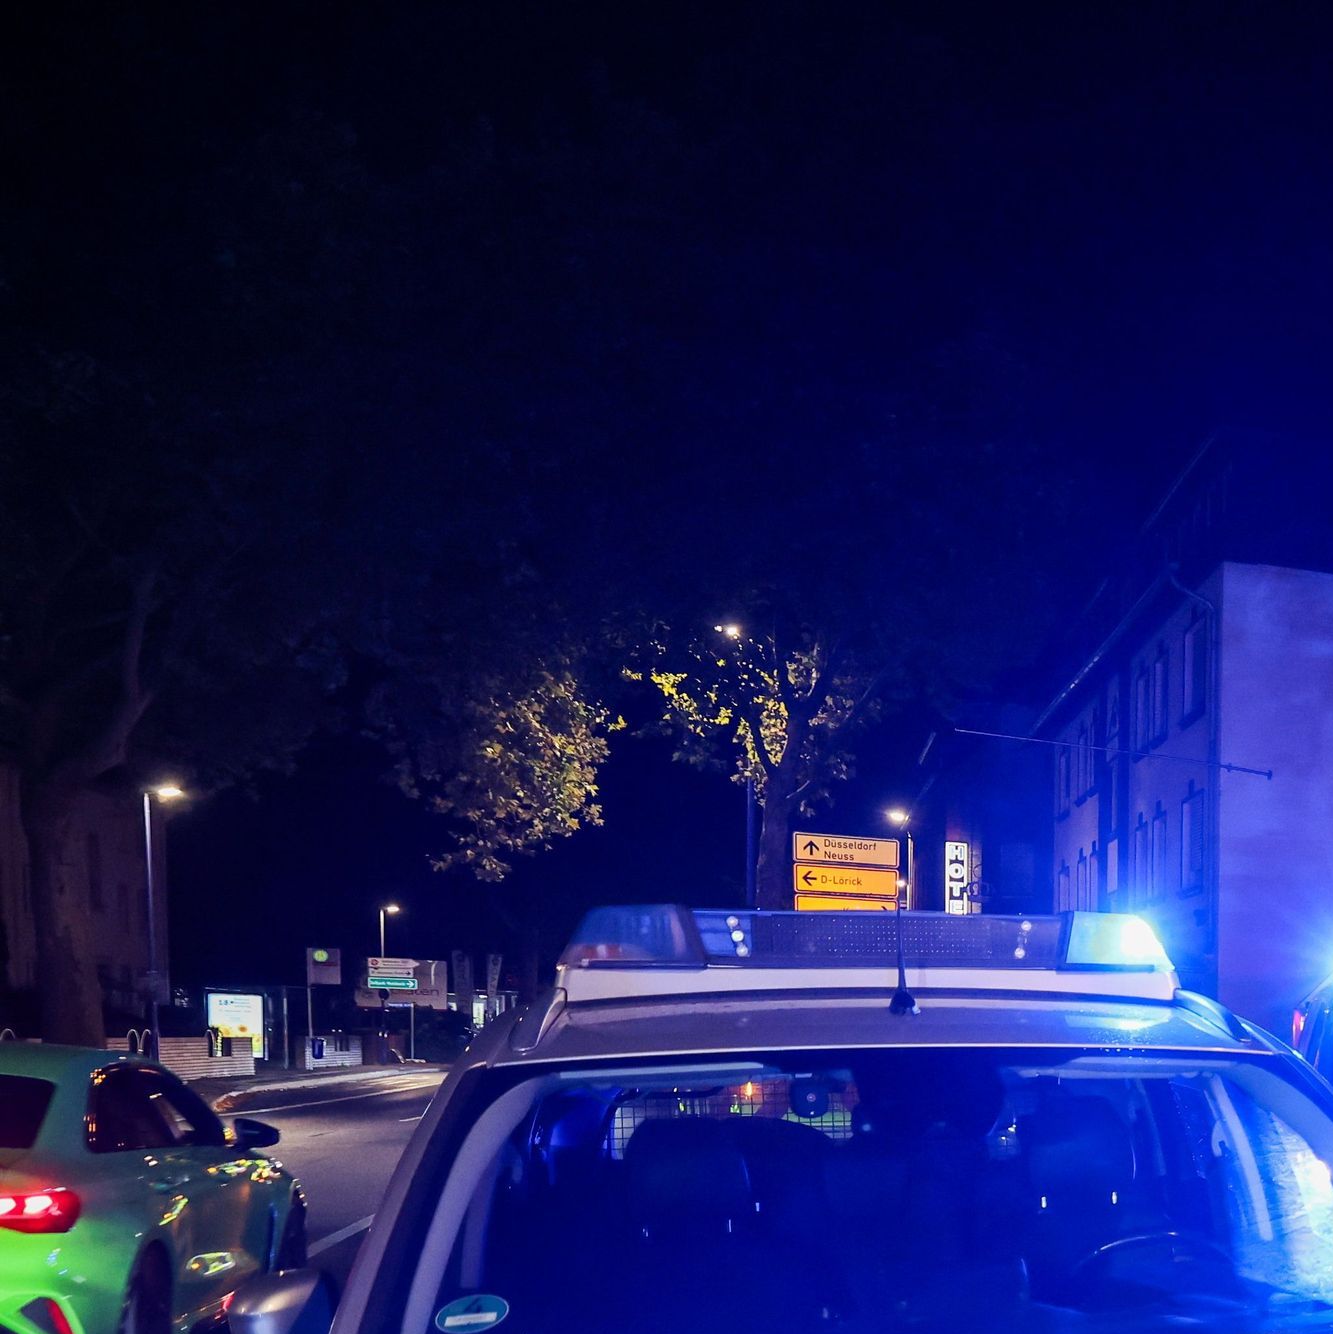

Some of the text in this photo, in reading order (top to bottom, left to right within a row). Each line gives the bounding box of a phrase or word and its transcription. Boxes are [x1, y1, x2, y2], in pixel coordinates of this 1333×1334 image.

[824, 838, 877, 851] Düsseldorf
[824, 851, 855, 861] Neuss
[820, 875, 862, 886] D-Lörick
[949, 845, 964, 913] HOTE
